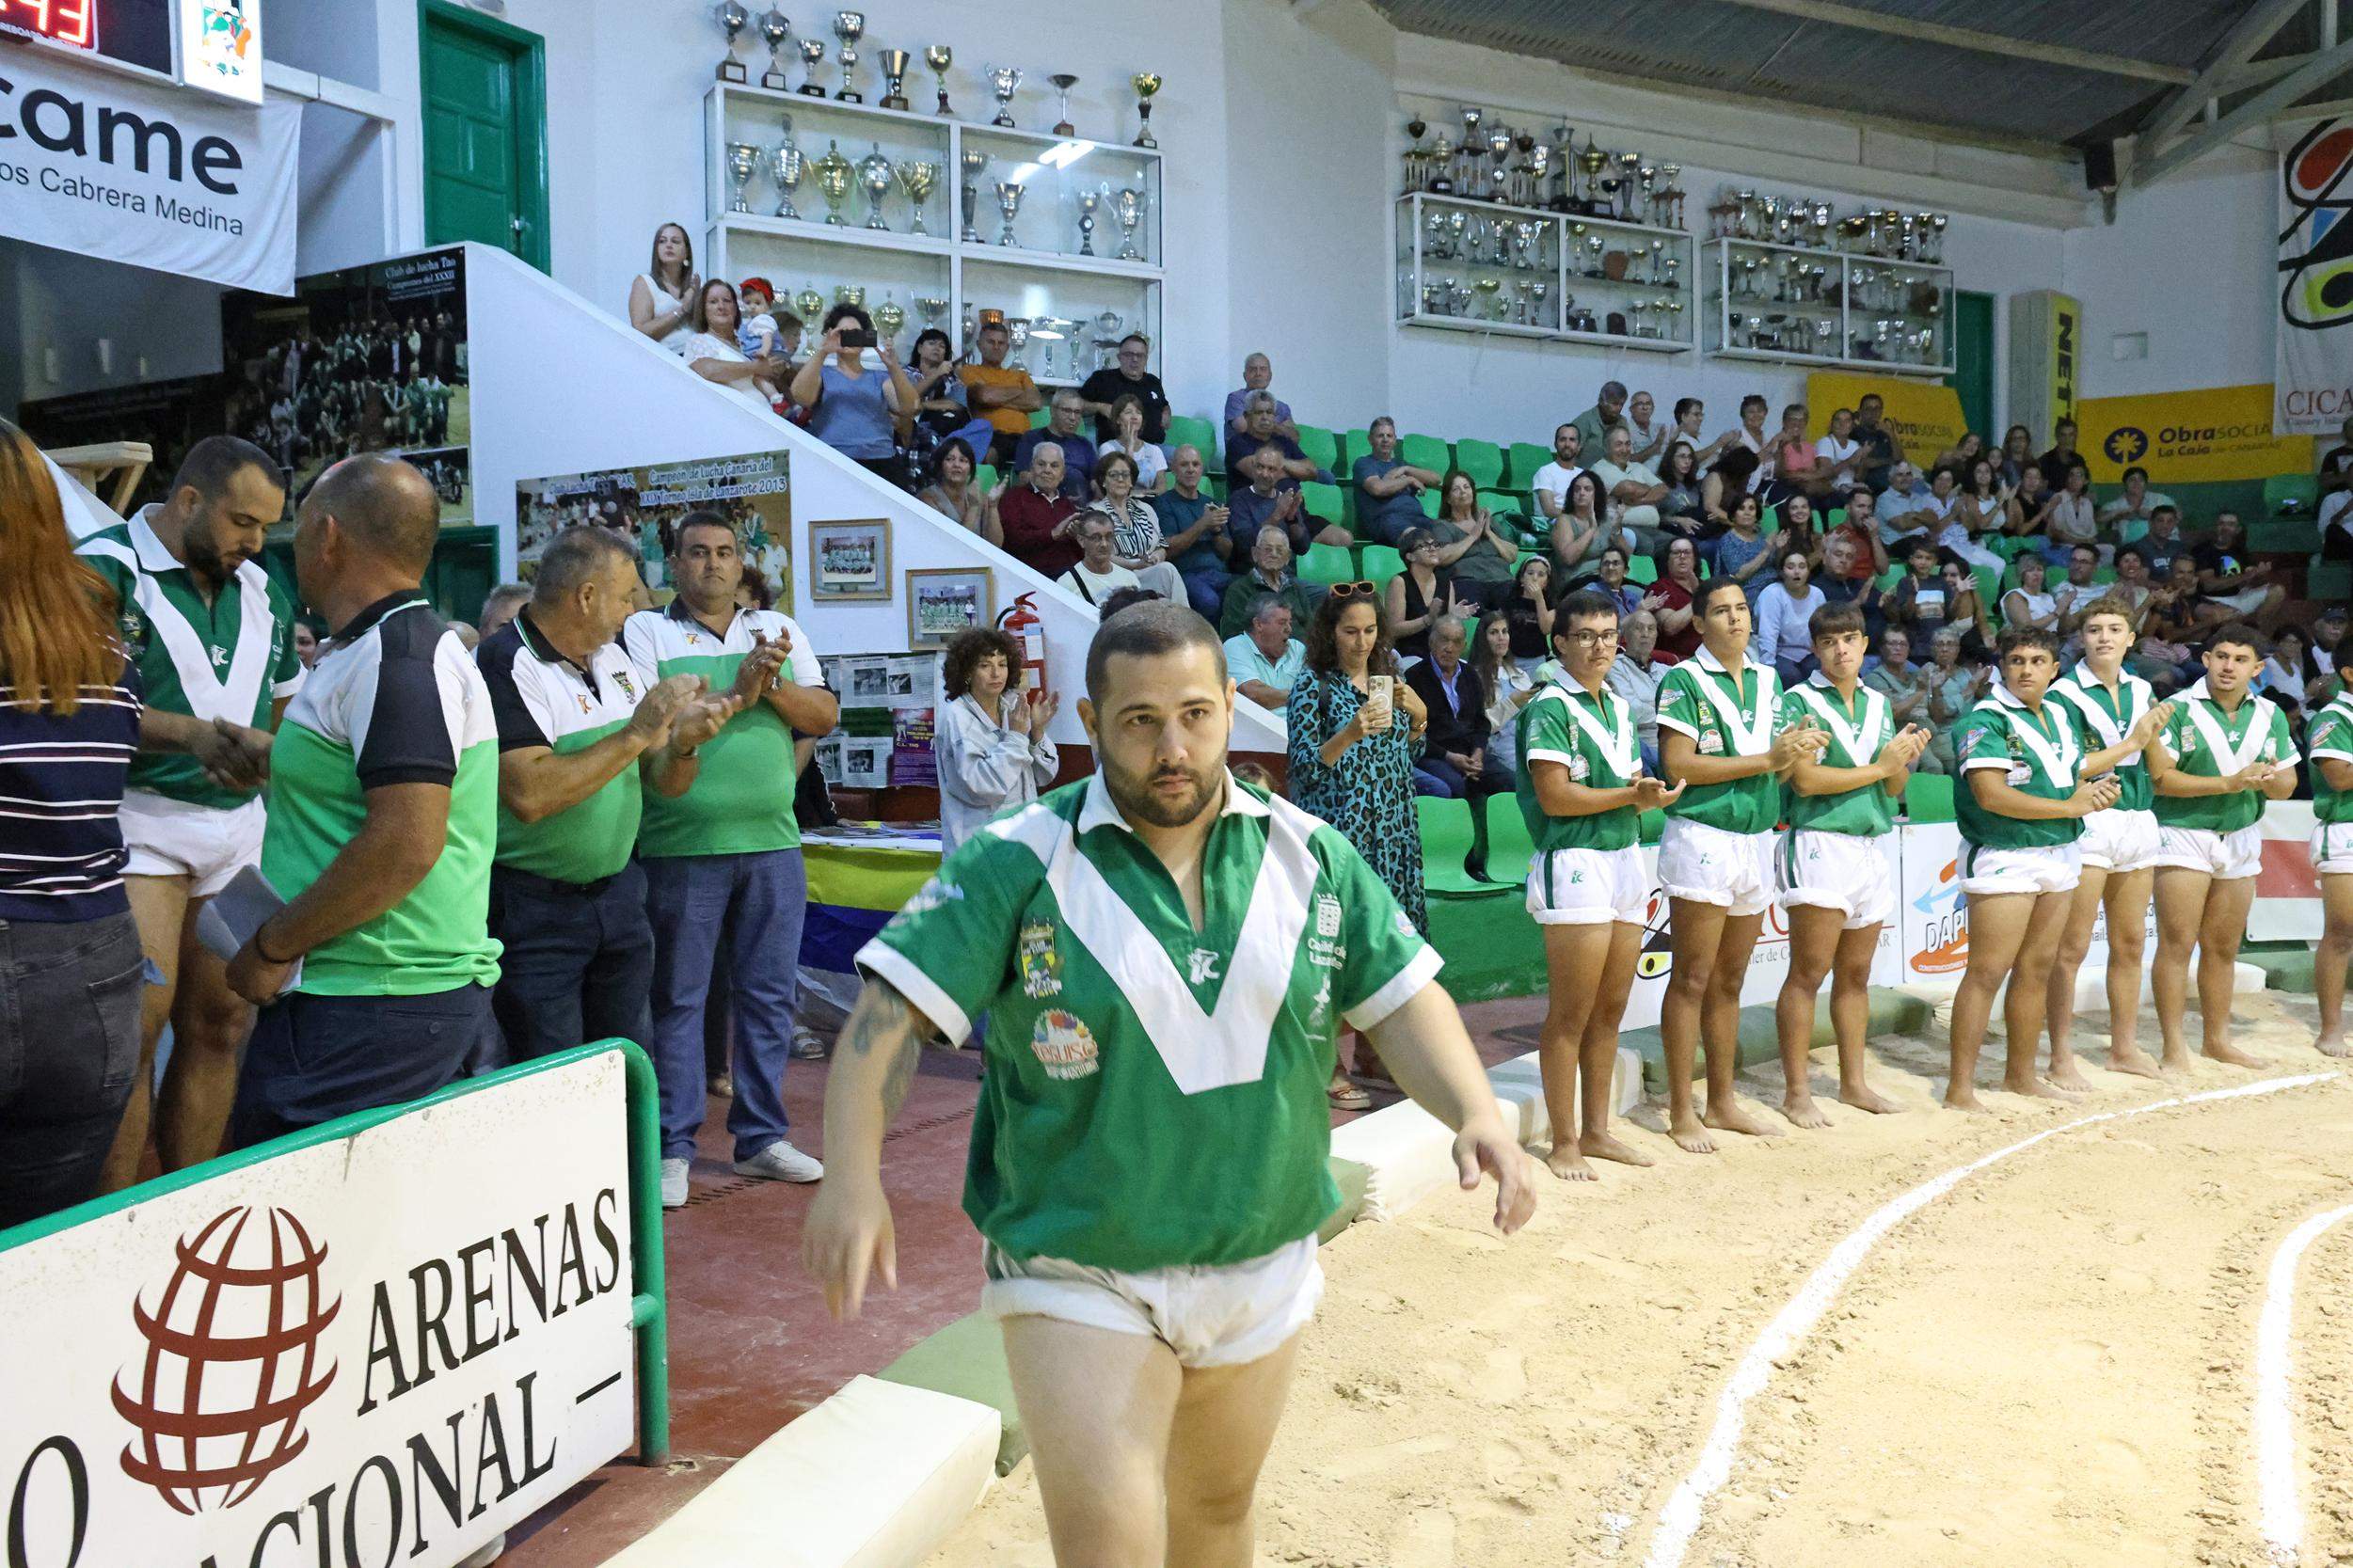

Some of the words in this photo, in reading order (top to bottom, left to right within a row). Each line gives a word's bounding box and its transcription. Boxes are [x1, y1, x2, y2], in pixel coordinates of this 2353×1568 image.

[0, 76, 243, 196] ame
[40, 166, 146, 214] Cabrera
[155, 194, 244, 236] Medina
[2157, 447, 2174, 458] La
[2178, 444, 2211, 457] Caja
[688, 467, 700, 481] de
[700, 463, 724, 478] Lucha
[725, 460, 757, 476] Canaria
[758, 457, 773, 472] del
[687, 486, 703, 502] Isla
[703, 485, 715, 499] de
[716, 483, 757, 499] Lanzarote
[758, 477, 787, 494] 2013
[1767, 948, 1778, 961] de
[357, 1187, 622, 1417] ARENAS
